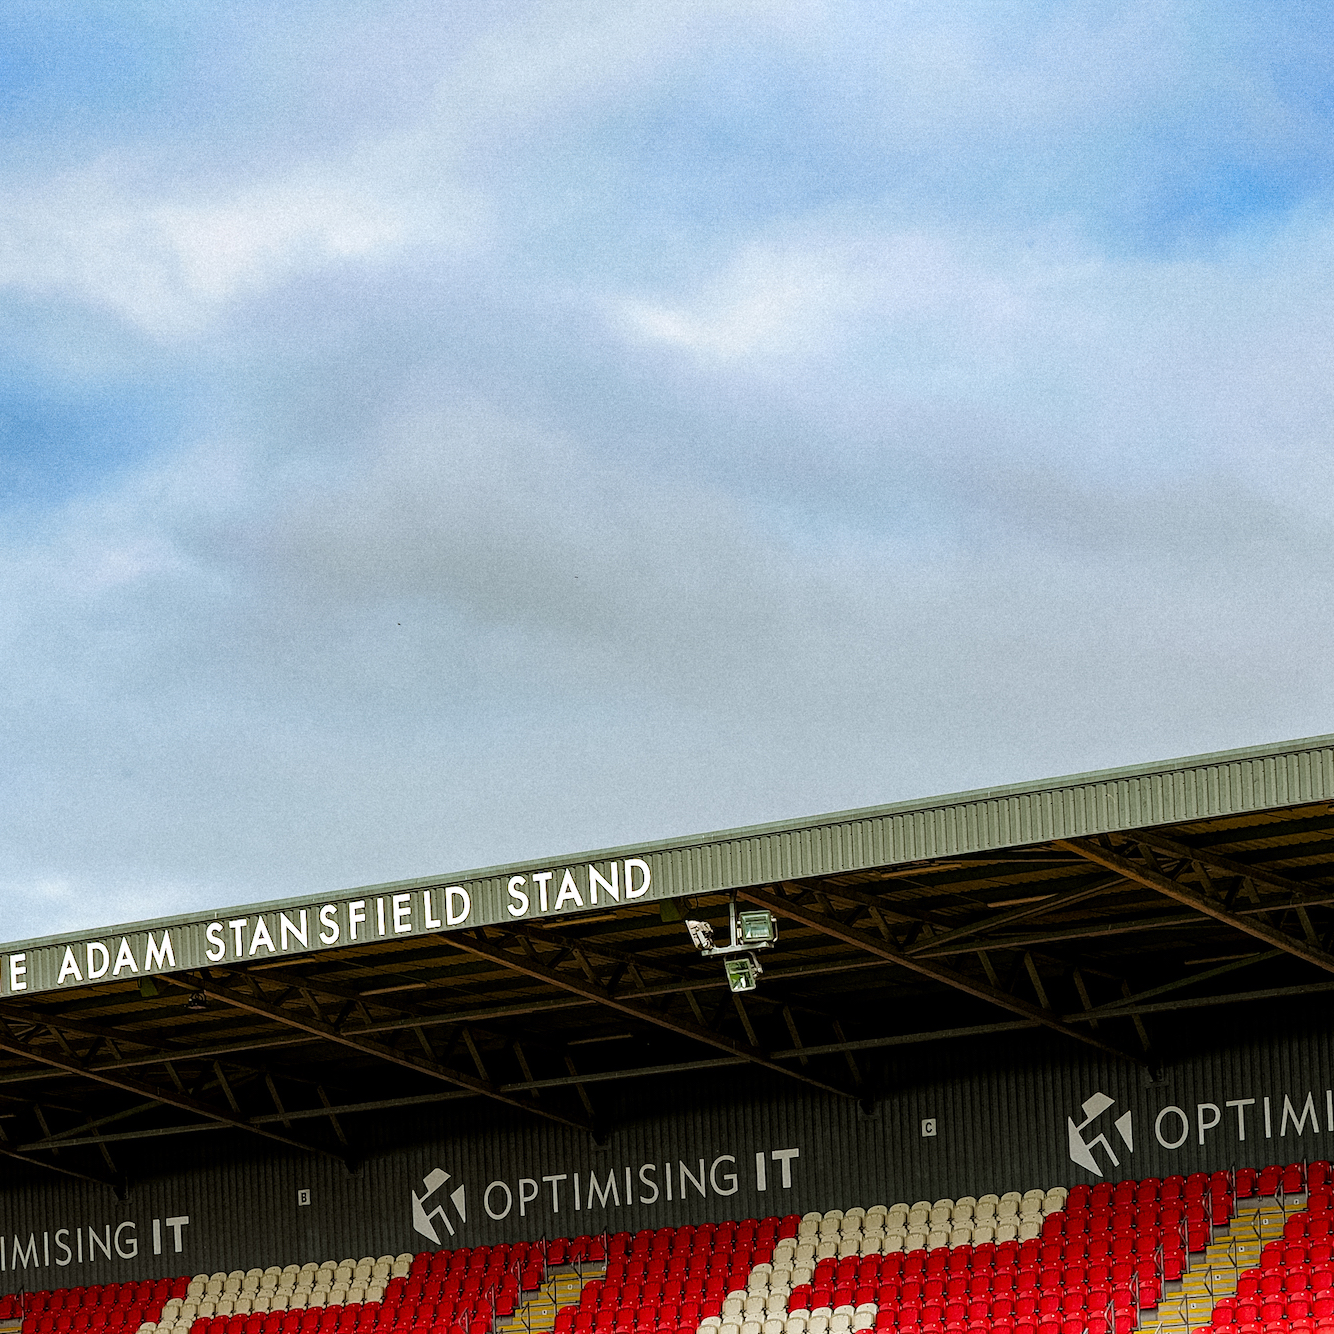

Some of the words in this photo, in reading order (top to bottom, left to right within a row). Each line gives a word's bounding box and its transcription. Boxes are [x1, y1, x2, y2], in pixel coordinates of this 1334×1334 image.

[57, 931, 176, 985] ADAM
[205, 885, 472, 963] STANSFIELD
[507, 857, 652, 918] STAND
[483, 1154, 739, 1221] OPTIMISING
[756, 1147, 800, 1192] IT
[152, 1216, 190, 1255] IT
